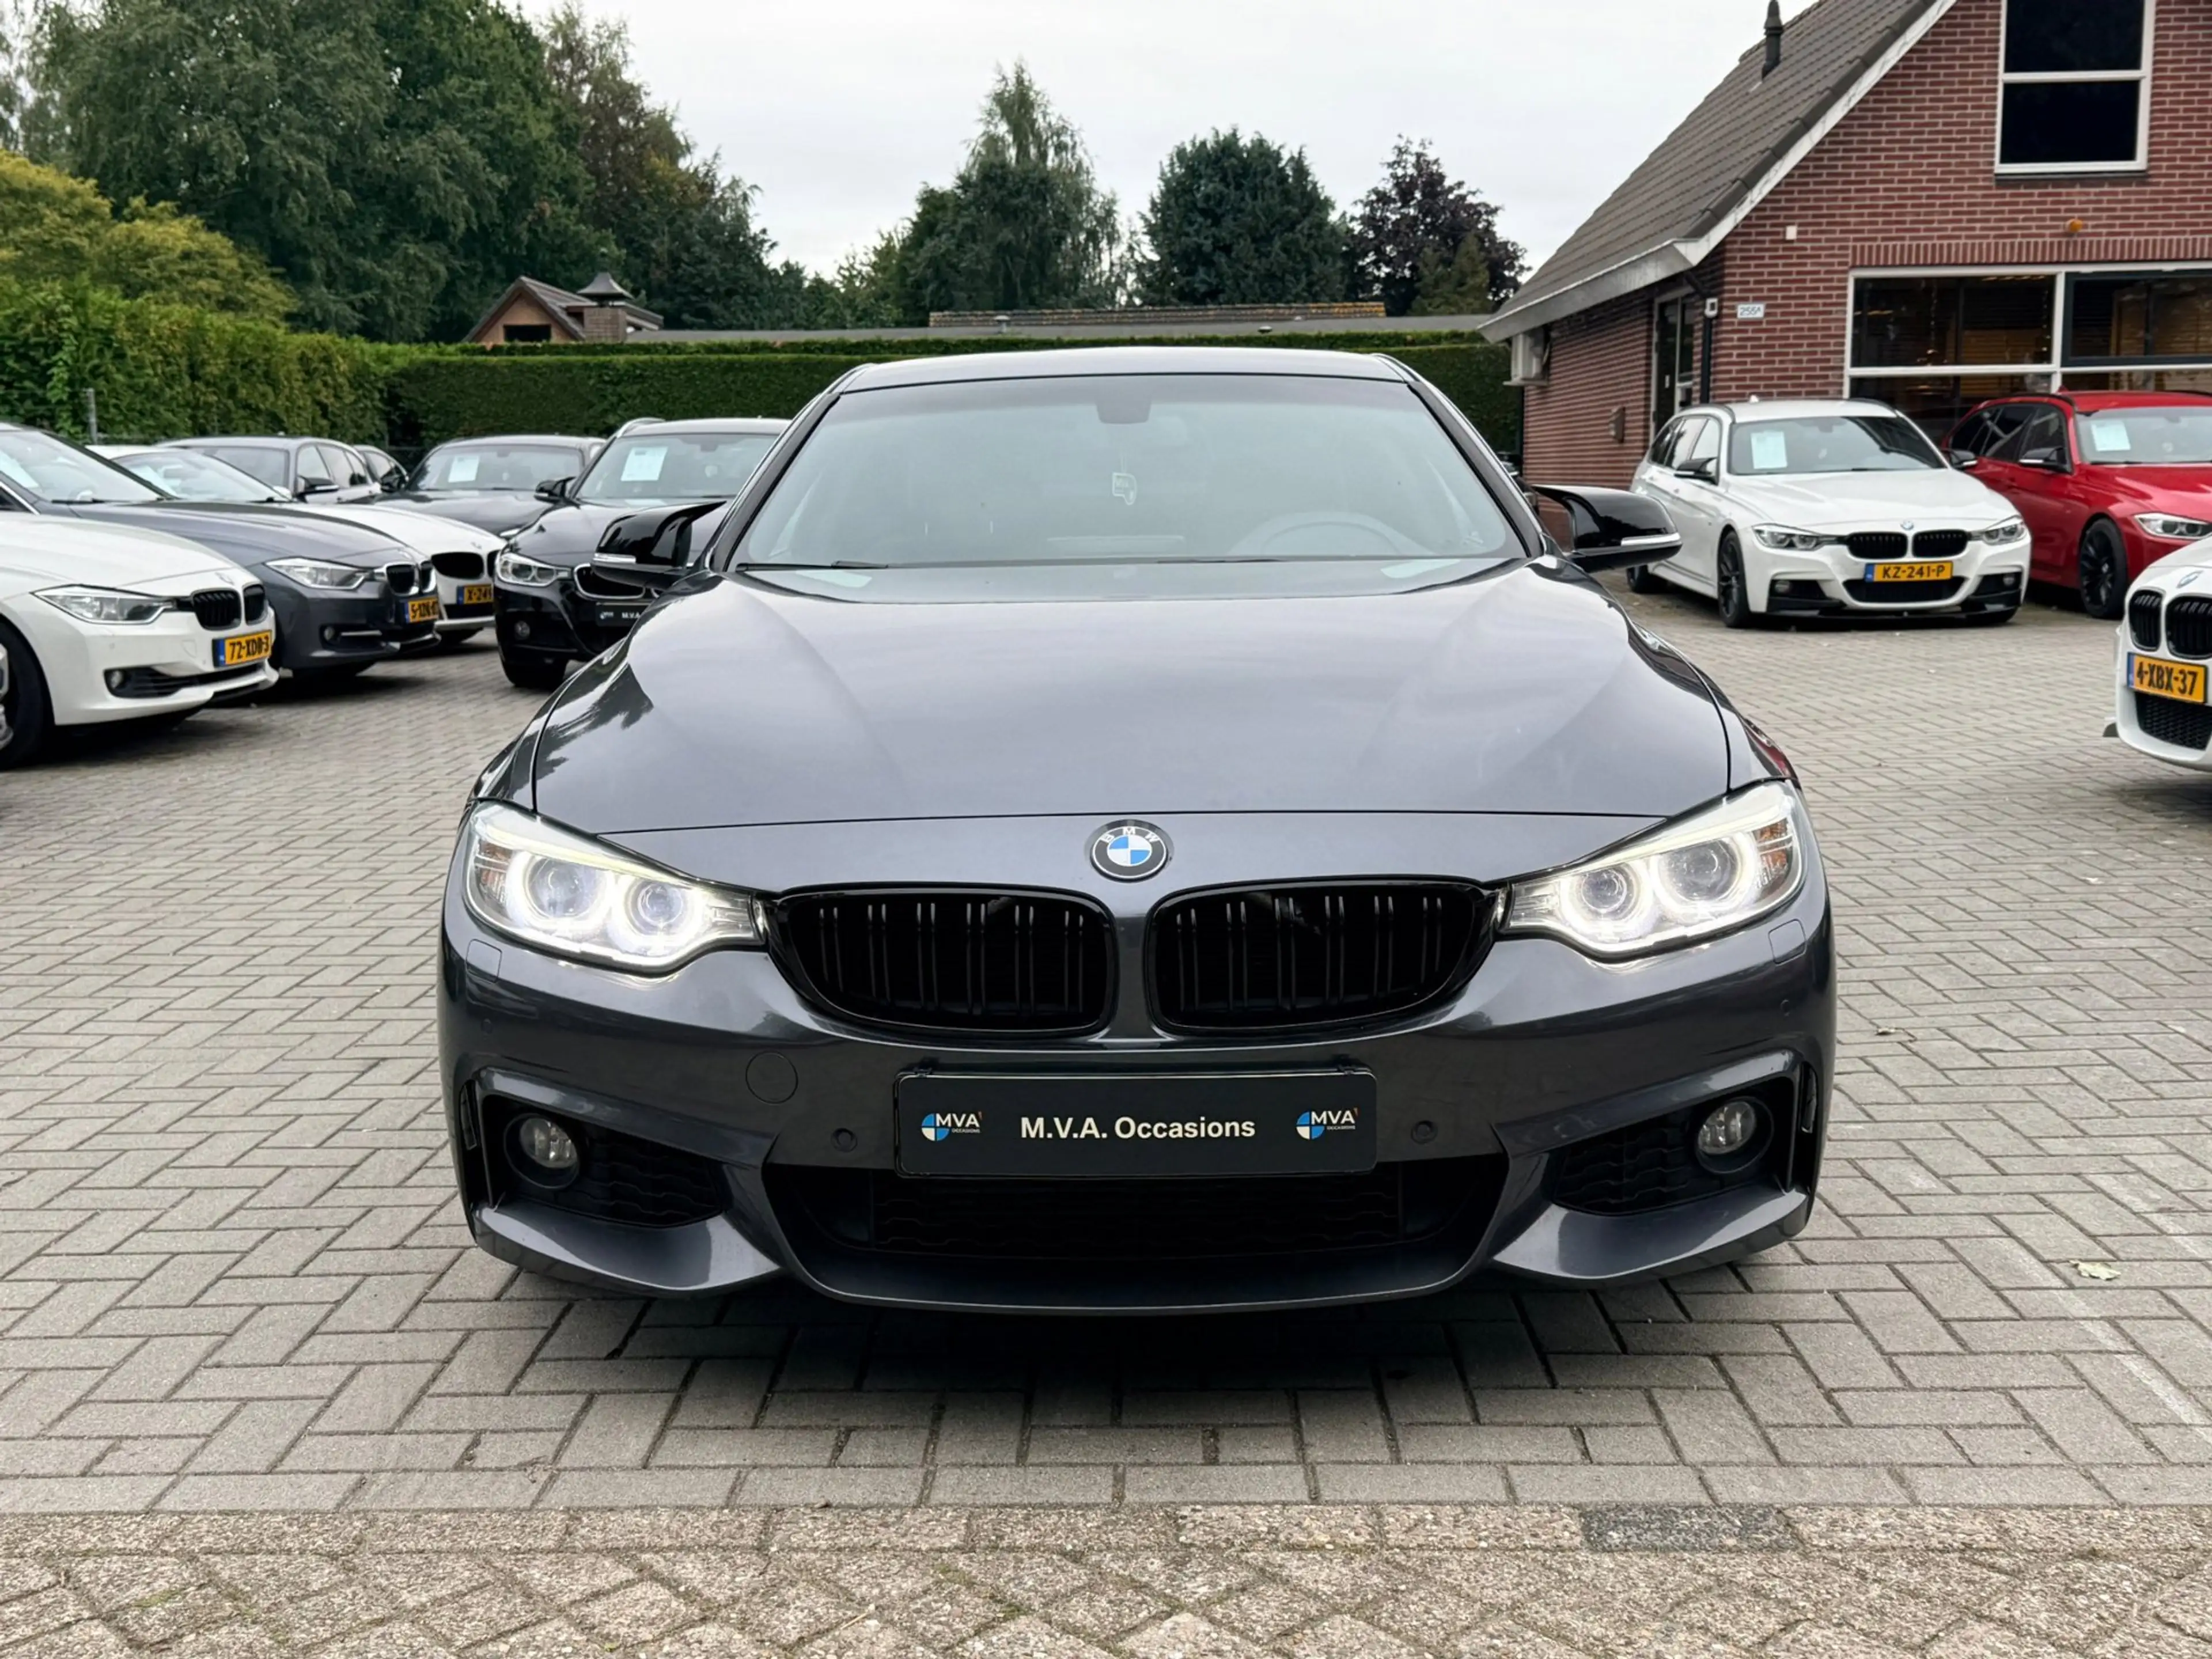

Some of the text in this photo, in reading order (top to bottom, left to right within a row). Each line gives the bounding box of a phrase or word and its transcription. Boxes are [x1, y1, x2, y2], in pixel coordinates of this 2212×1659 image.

[1882, 565, 1946, 578] KZ-241-P
[2137, 661, 2199, 696] 4-XBX-37
[1099, 827, 1160, 843] BMW
[935, 1113, 980, 1127] MVA
[1311, 1110, 1355, 1125] MVA
[1020, 1116, 1256, 1139] M.V.A. Occasions
